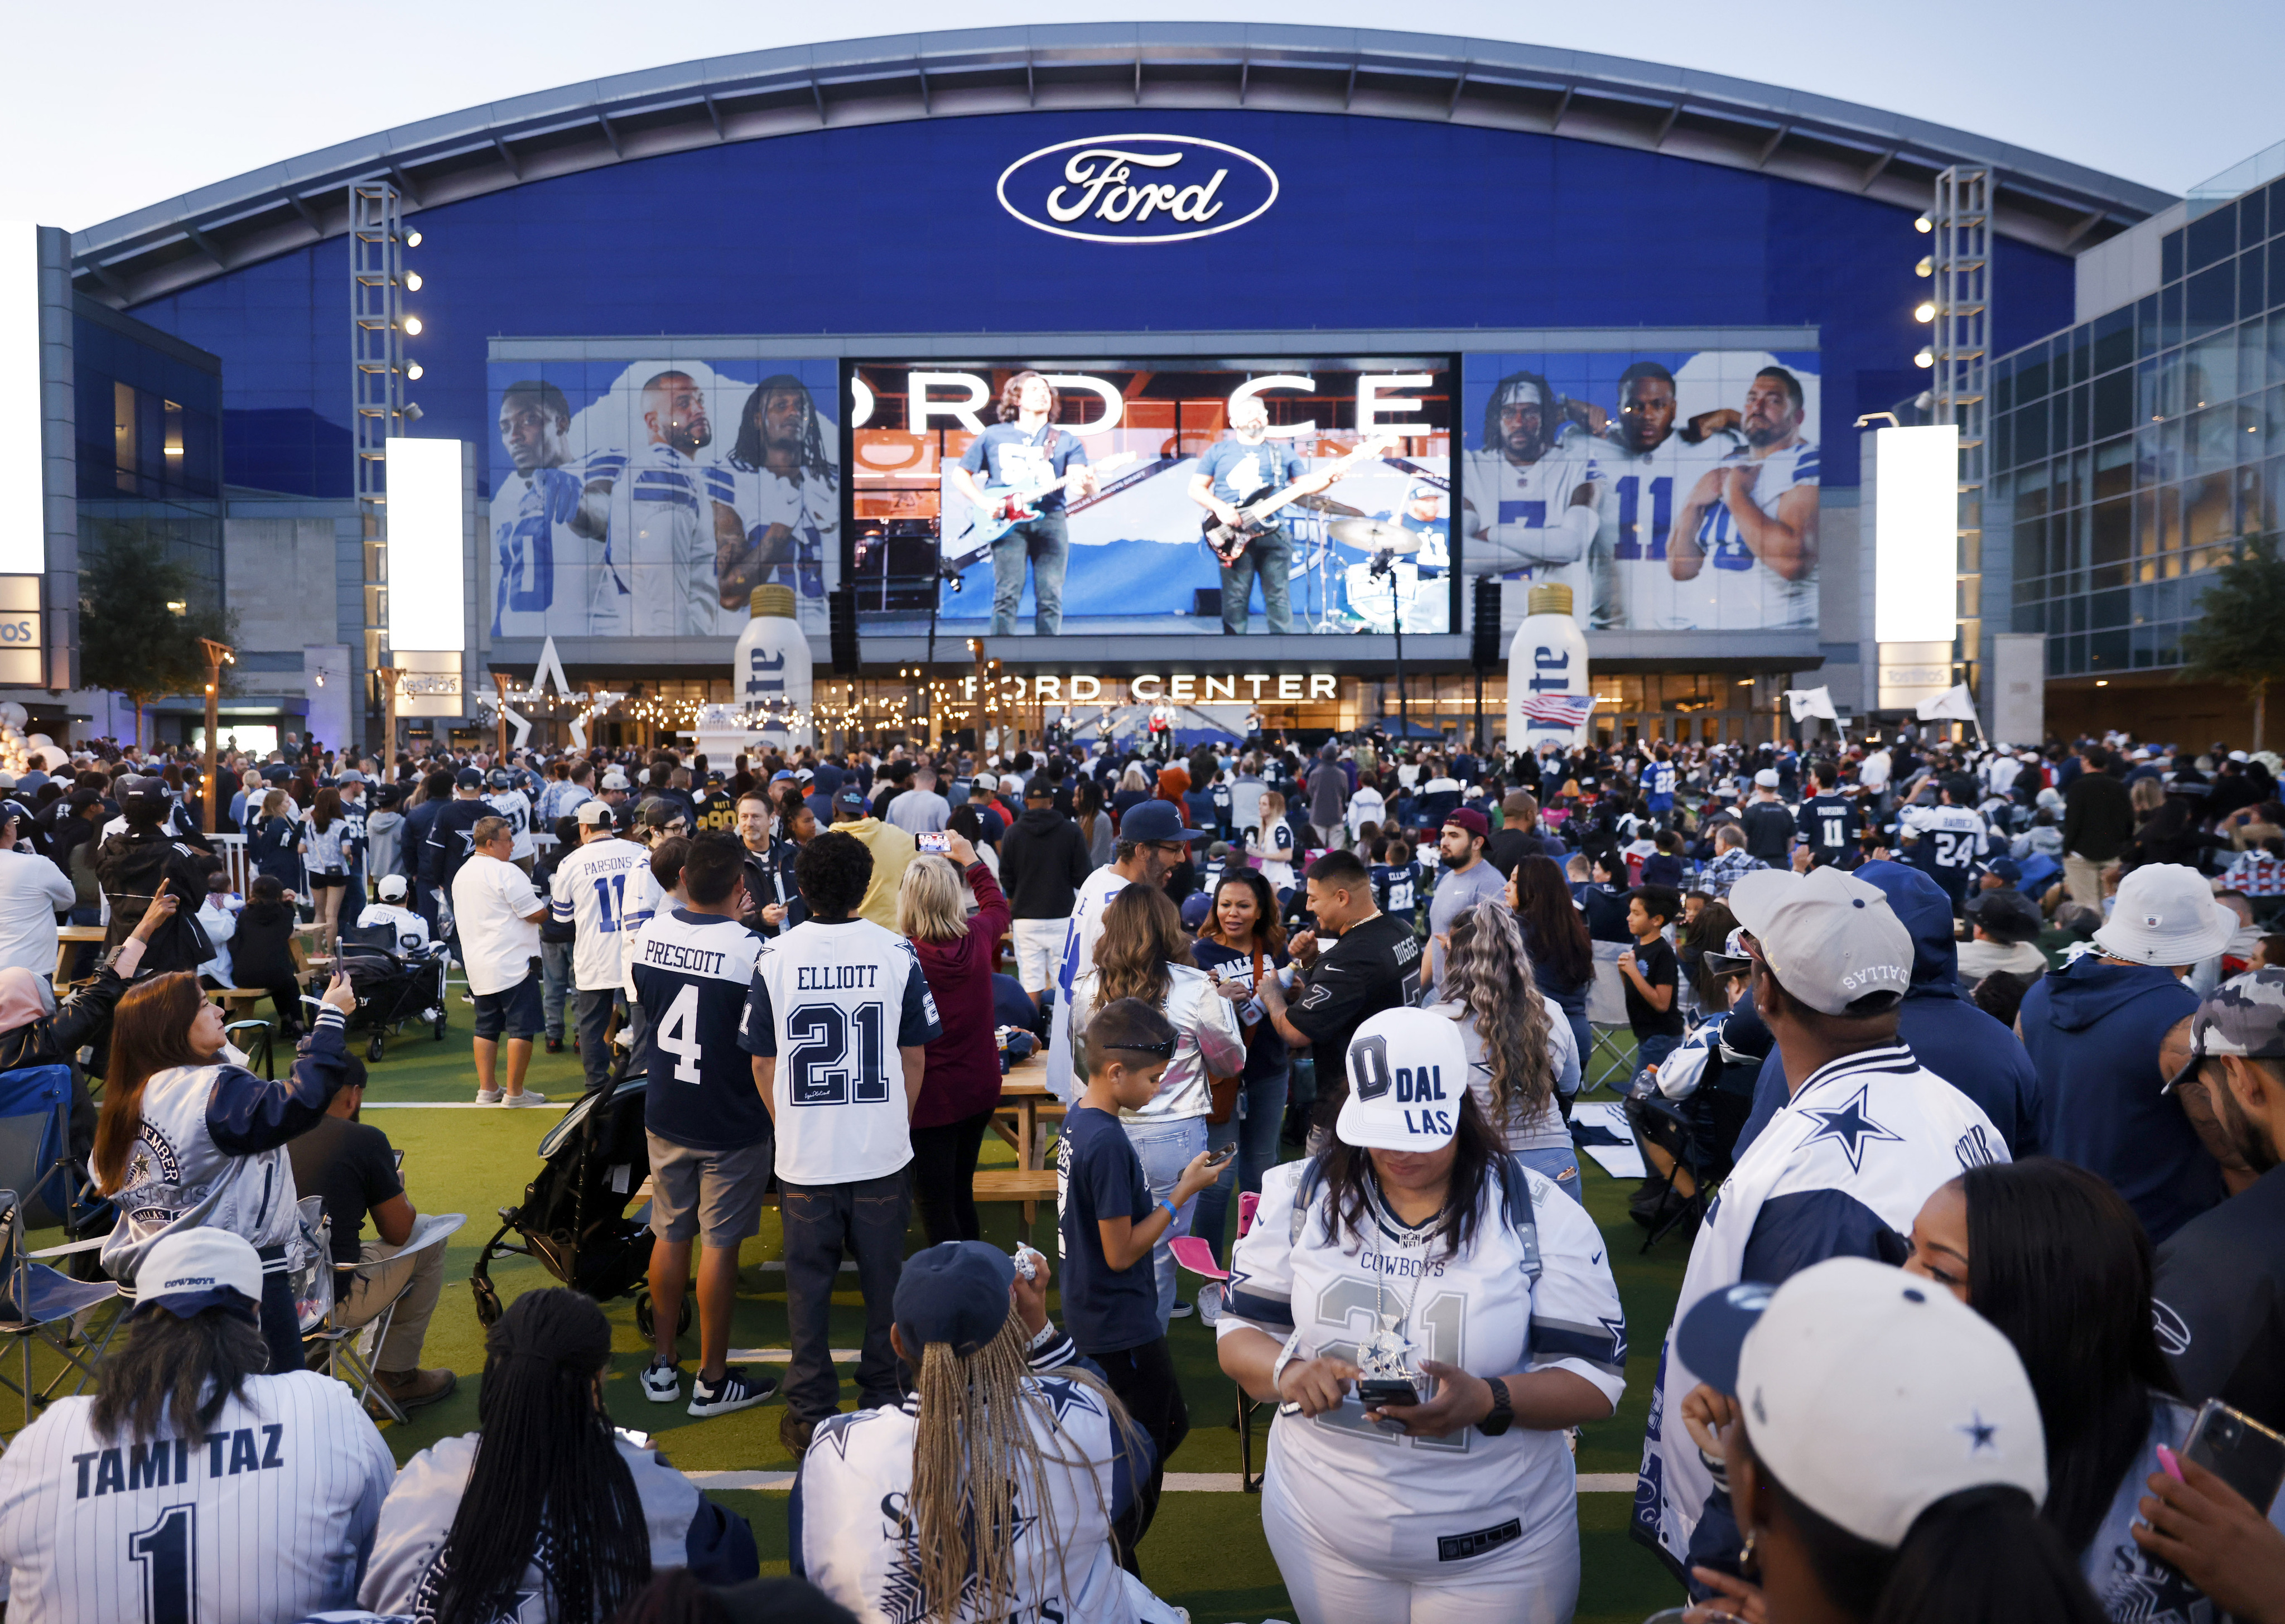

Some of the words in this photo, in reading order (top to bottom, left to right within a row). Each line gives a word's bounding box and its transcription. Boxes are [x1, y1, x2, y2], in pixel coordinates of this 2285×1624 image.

[1047, 149, 1228, 222] Ford
[1614, 475, 1674, 561] 11
[965, 675, 1101, 700] FORD
[1131, 674, 1337, 700] CENTER
[1526, 646, 1575, 734] Lte
[345, 815, 364, 838] 55
[1823, 818, 1845, 847] 11
[584, 856, 633, 876] PARSONS
[1935, 832, 1975, 869] 24
[1388, 880, 1415, 912] 21
[644, 939, 726, 975] PRESCOTT
[1392, 934, 1419, 966] DIGGS
[797, 964, 879, 990] ELLIOTT
[1843, 965, 1908, 991] DALLAS
[1302, 984, 1332, 1010] 7
[657, 984, 702, 1085] 4
[787, 1001, 890, 1107] 21
[1351, 1034, 1392, 1102] D
[1395, 1066, 1447, 1103] DAL
[1404, 1109, 1453, 1136] LAS
[135, 1210, 165, 1221] DALLAS
[1361, 1251, 1445, 1278] COWBOYS
[163, 1276, 216, 1289] COWBOYS
[1313, 1273, 1472, 1454] 21
[72, 1438, 189, 1500] TAMI
[200, 1423, 284, 1479] TAZ
[129, 1502, 197, 1624] 1
